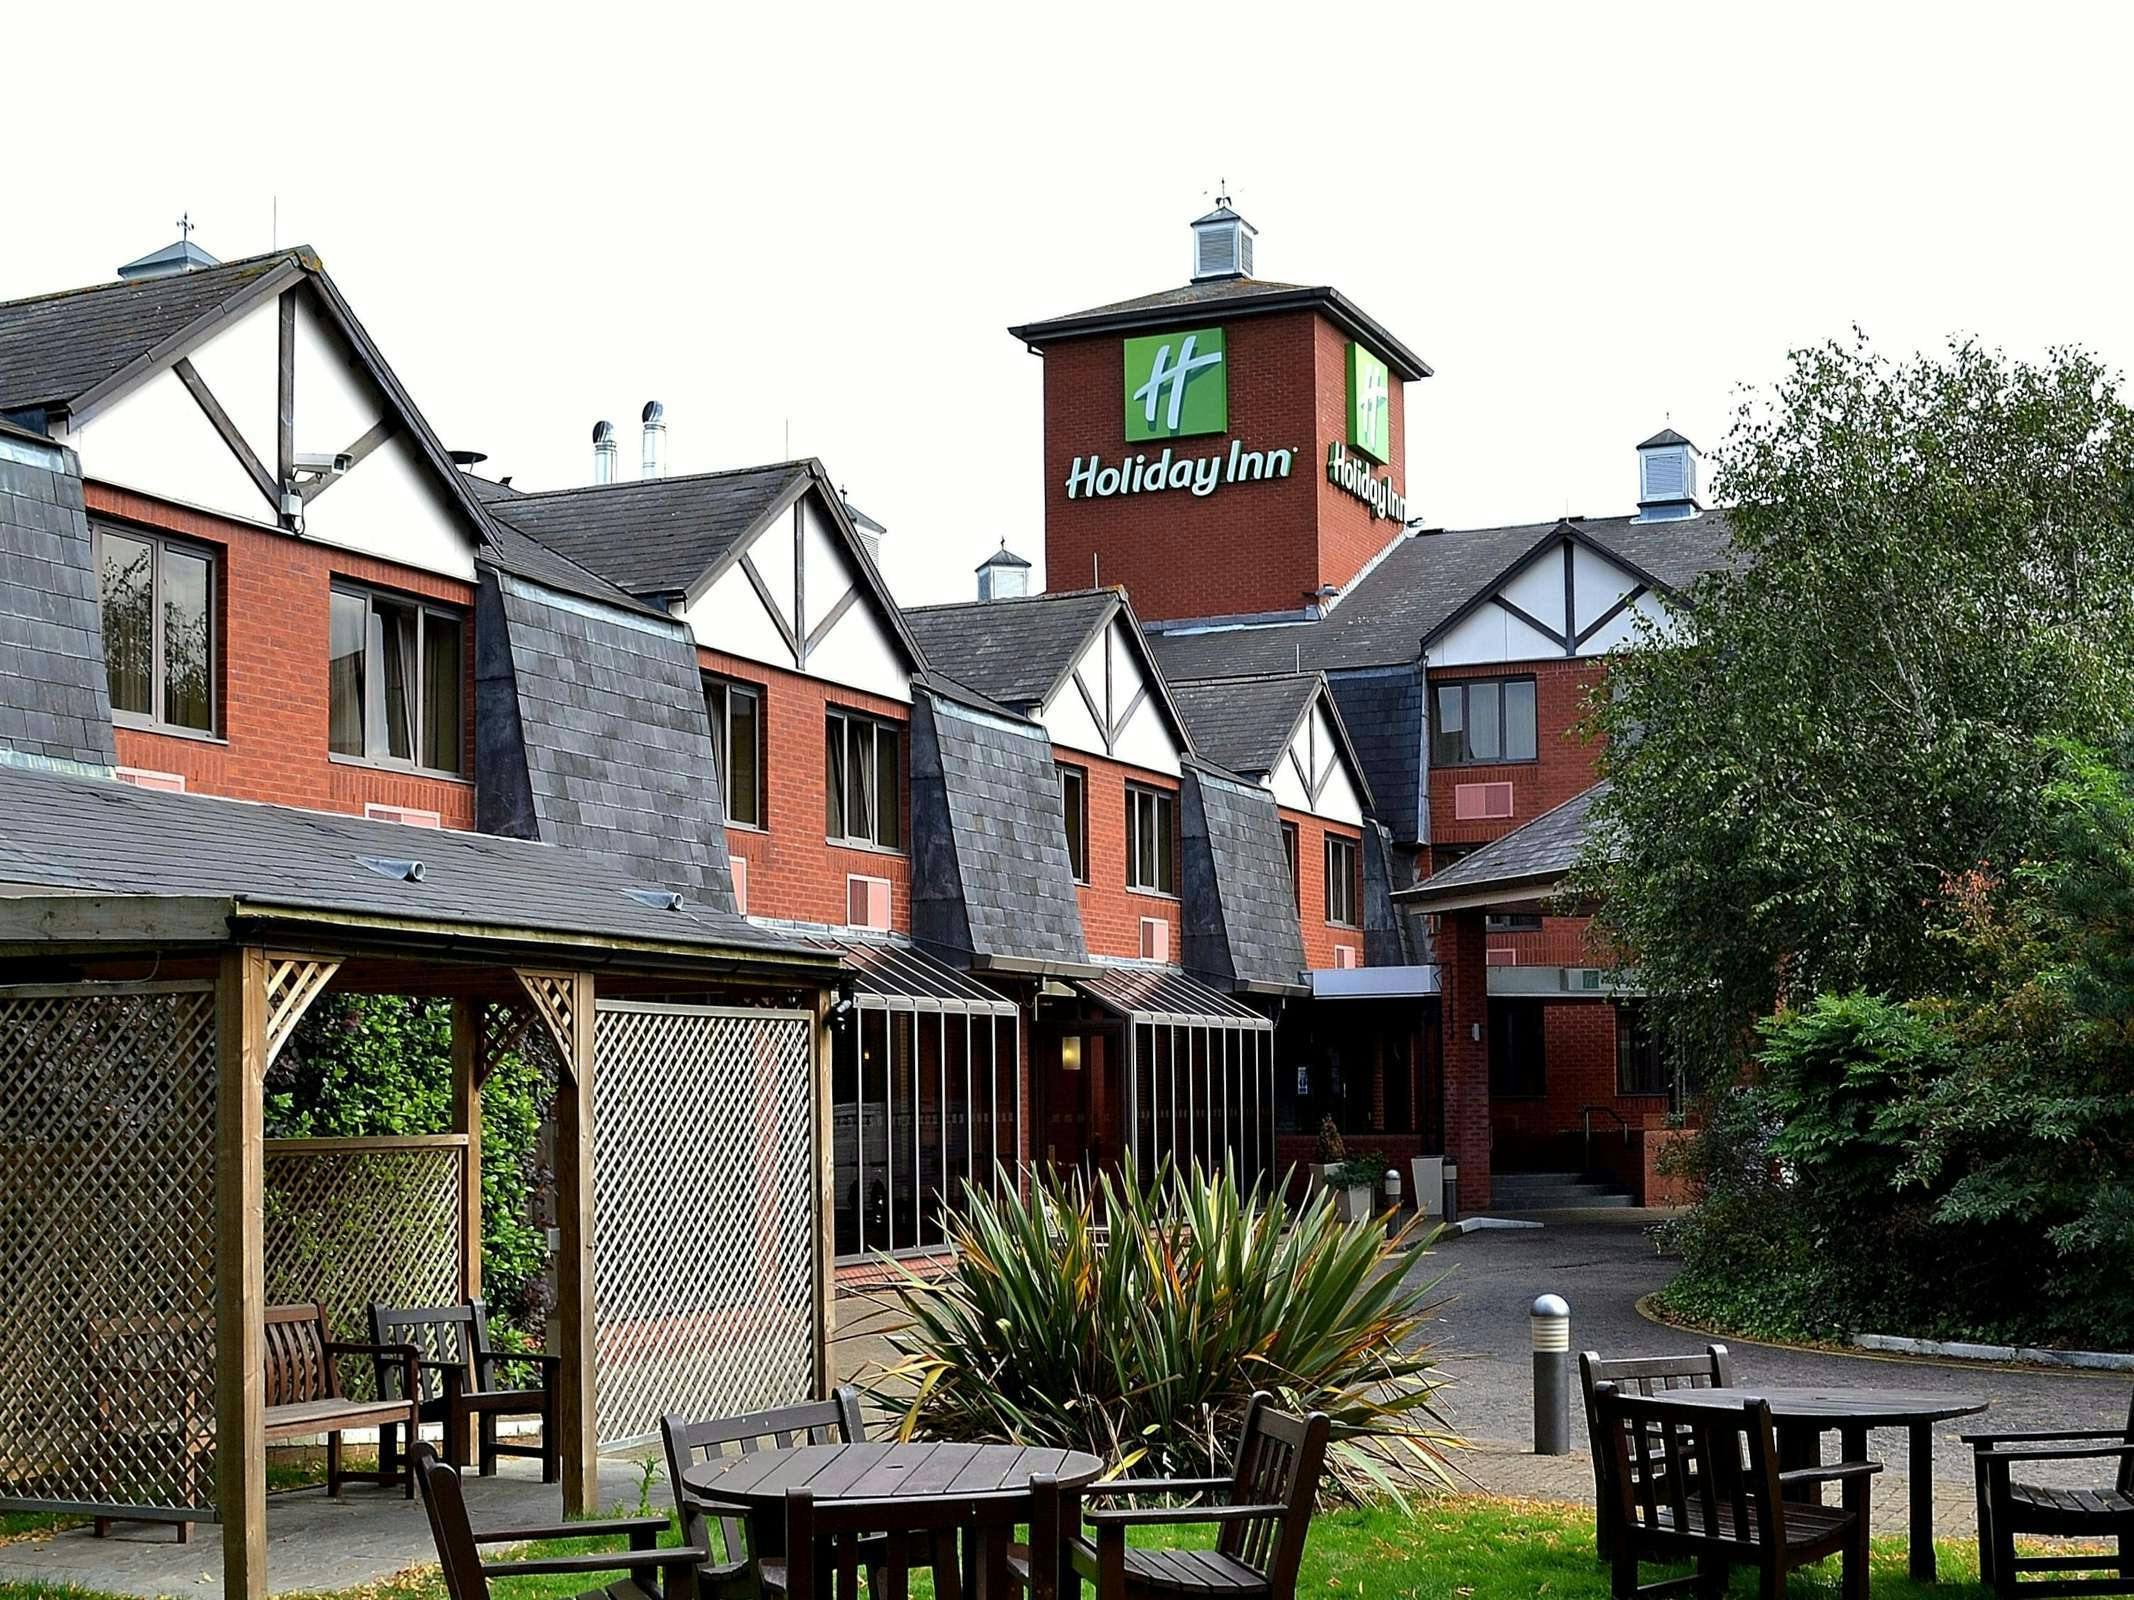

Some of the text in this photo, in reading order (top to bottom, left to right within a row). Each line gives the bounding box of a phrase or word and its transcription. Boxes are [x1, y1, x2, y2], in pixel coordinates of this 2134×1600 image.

[1133, 335, 1222, 430] H
[1066, 440, 1291, 498] Holiday Inn
[1330, 441, 1387, 520] Holiday
